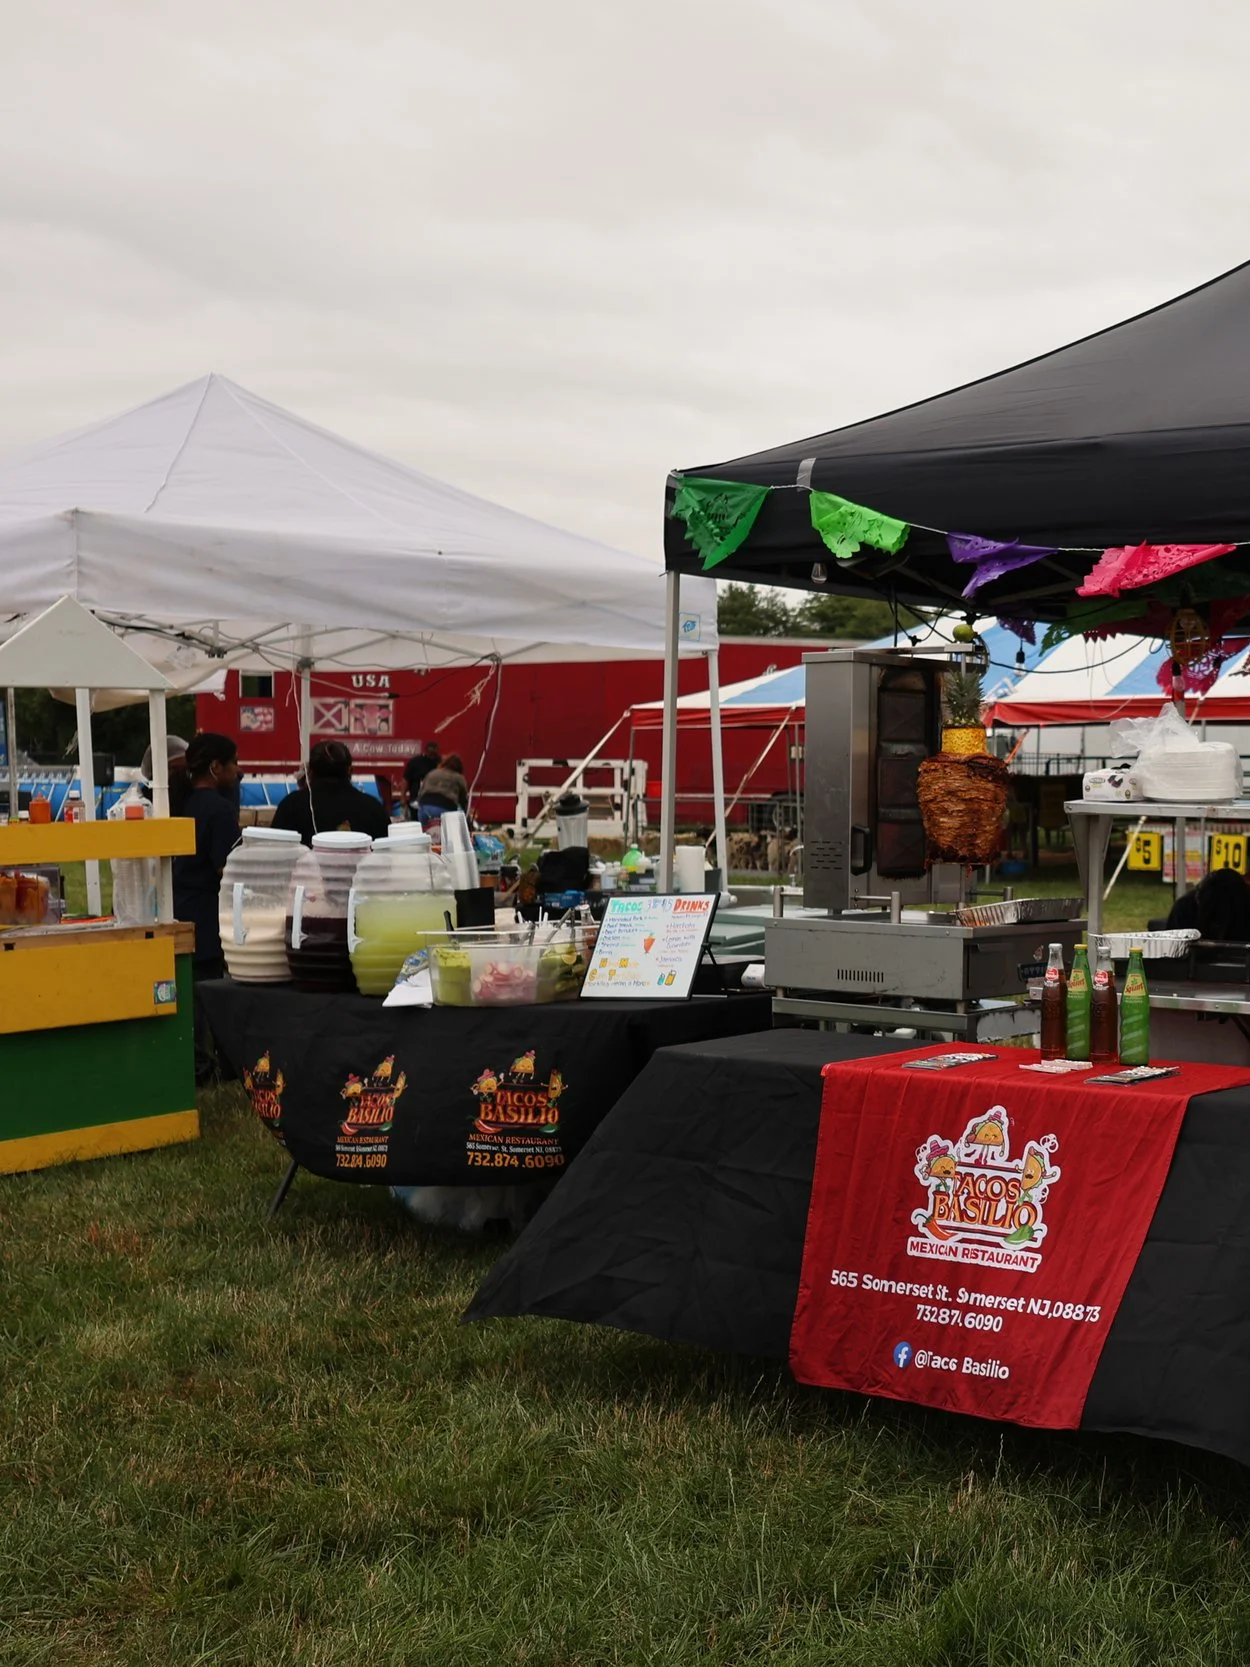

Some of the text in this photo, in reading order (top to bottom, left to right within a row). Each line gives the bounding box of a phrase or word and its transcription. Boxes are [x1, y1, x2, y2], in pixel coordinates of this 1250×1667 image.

[351, 674, 391, 688] USA
[673, 898, 710, 913] DRINKS
[347, 1106, 394, 1123] BASILIO
[480, 1103, 559, 1124] BASILIO
[468, 1133, 559, 1145] MEXICAN RESTAURANT
[953, 1172, 1022, 1203] TACOS
[933, 1191, 1038, 1230] BASILIO
[909, 1240, 1039, 1269] MEXICN RSTAURANT
[830, 1269, 858, 1287] 565
[861, 1274, 934, 1299] Somerset
[935, 1284, 952, 1302] St.
[961, 1356, 1010, 1380] Basilio
